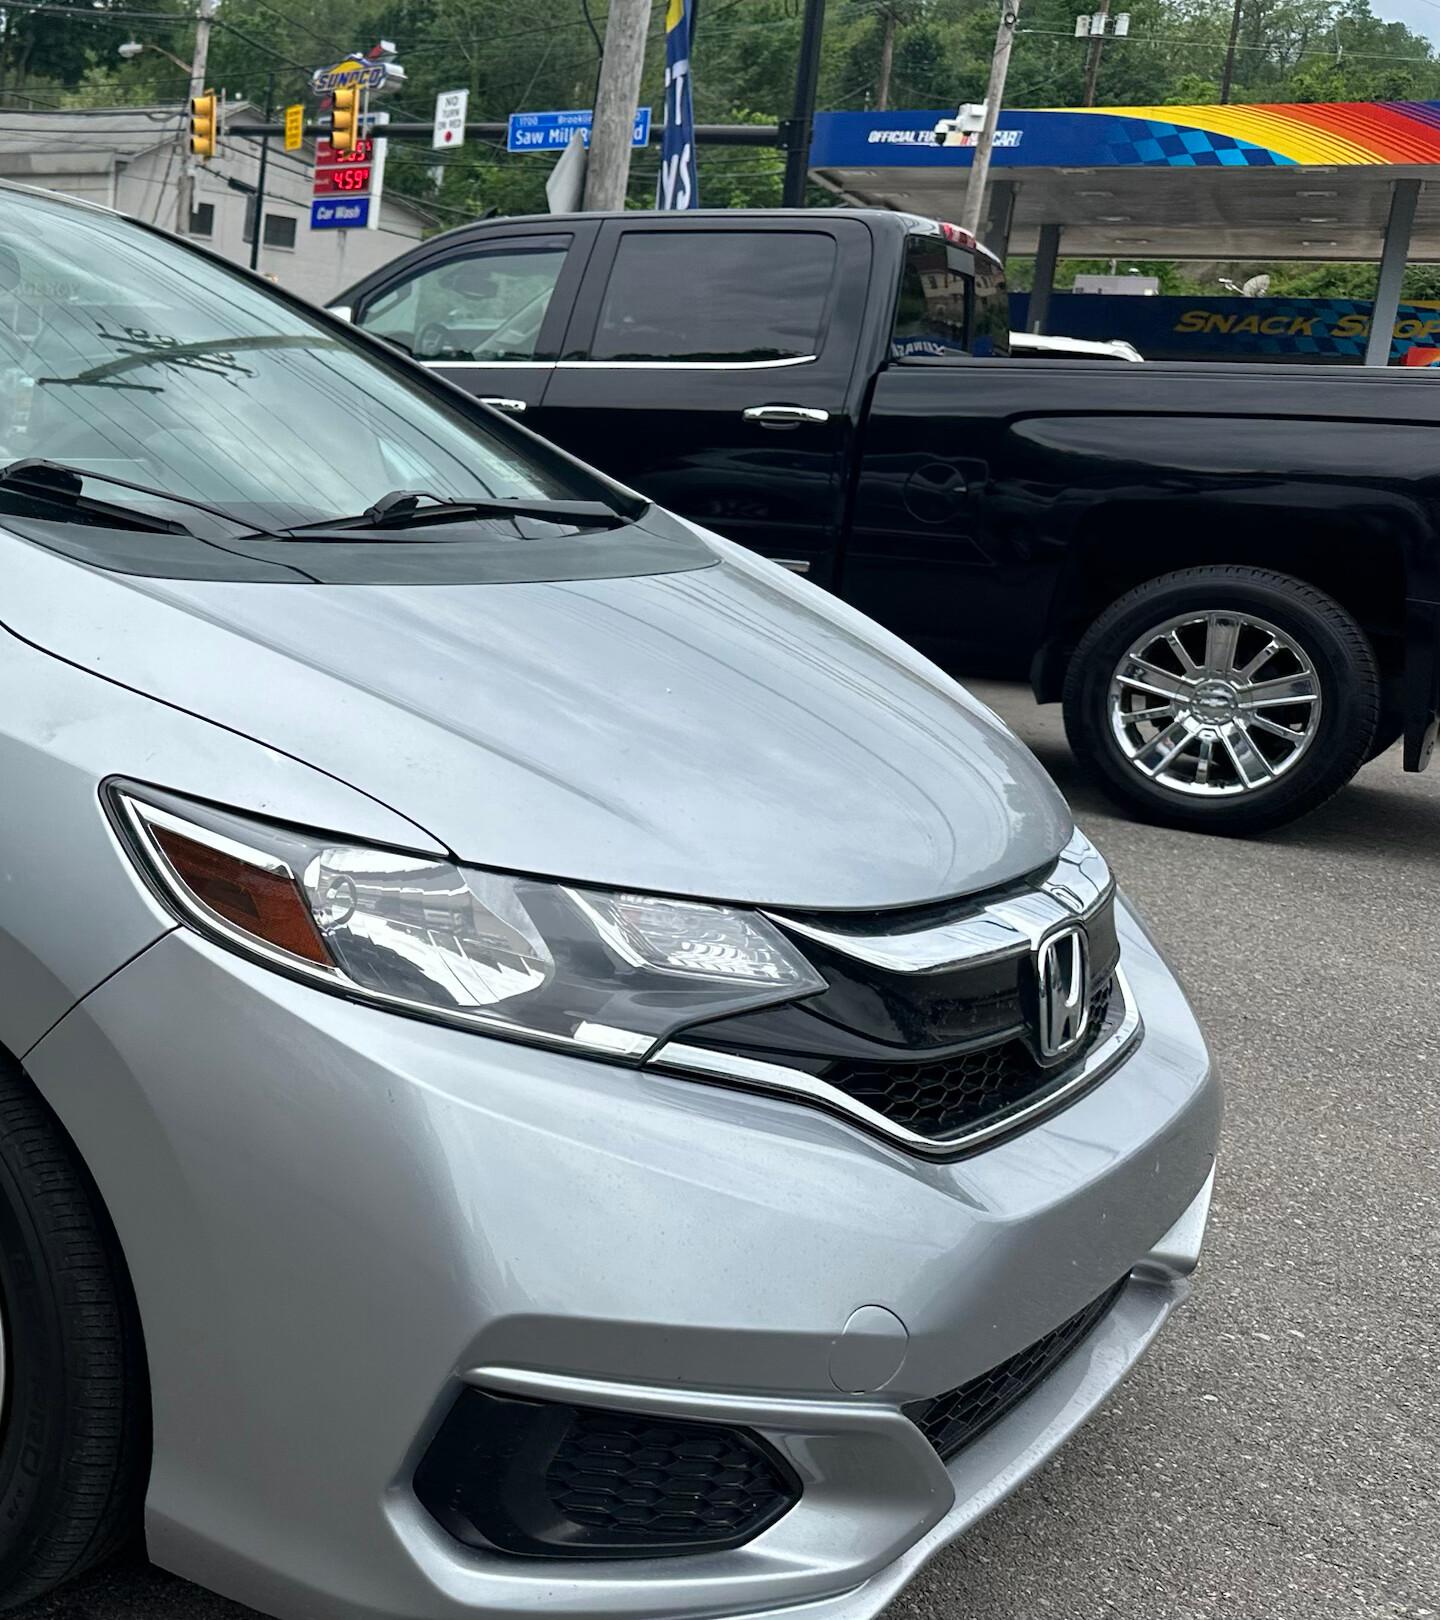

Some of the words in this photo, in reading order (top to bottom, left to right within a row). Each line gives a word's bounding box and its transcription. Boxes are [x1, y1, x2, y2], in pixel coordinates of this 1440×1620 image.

[318, 68, 380, 90] SUNOCO
[445, 95, 459, 107] NO
[515, 130, 545, 145] Saw
[868, 130, 916, 143] OFFICIAL
[316, 206, 334, 220] Car
[1173, 310, 1321, 336] SNACK
[1330, 314, 1440, 338] SOP
